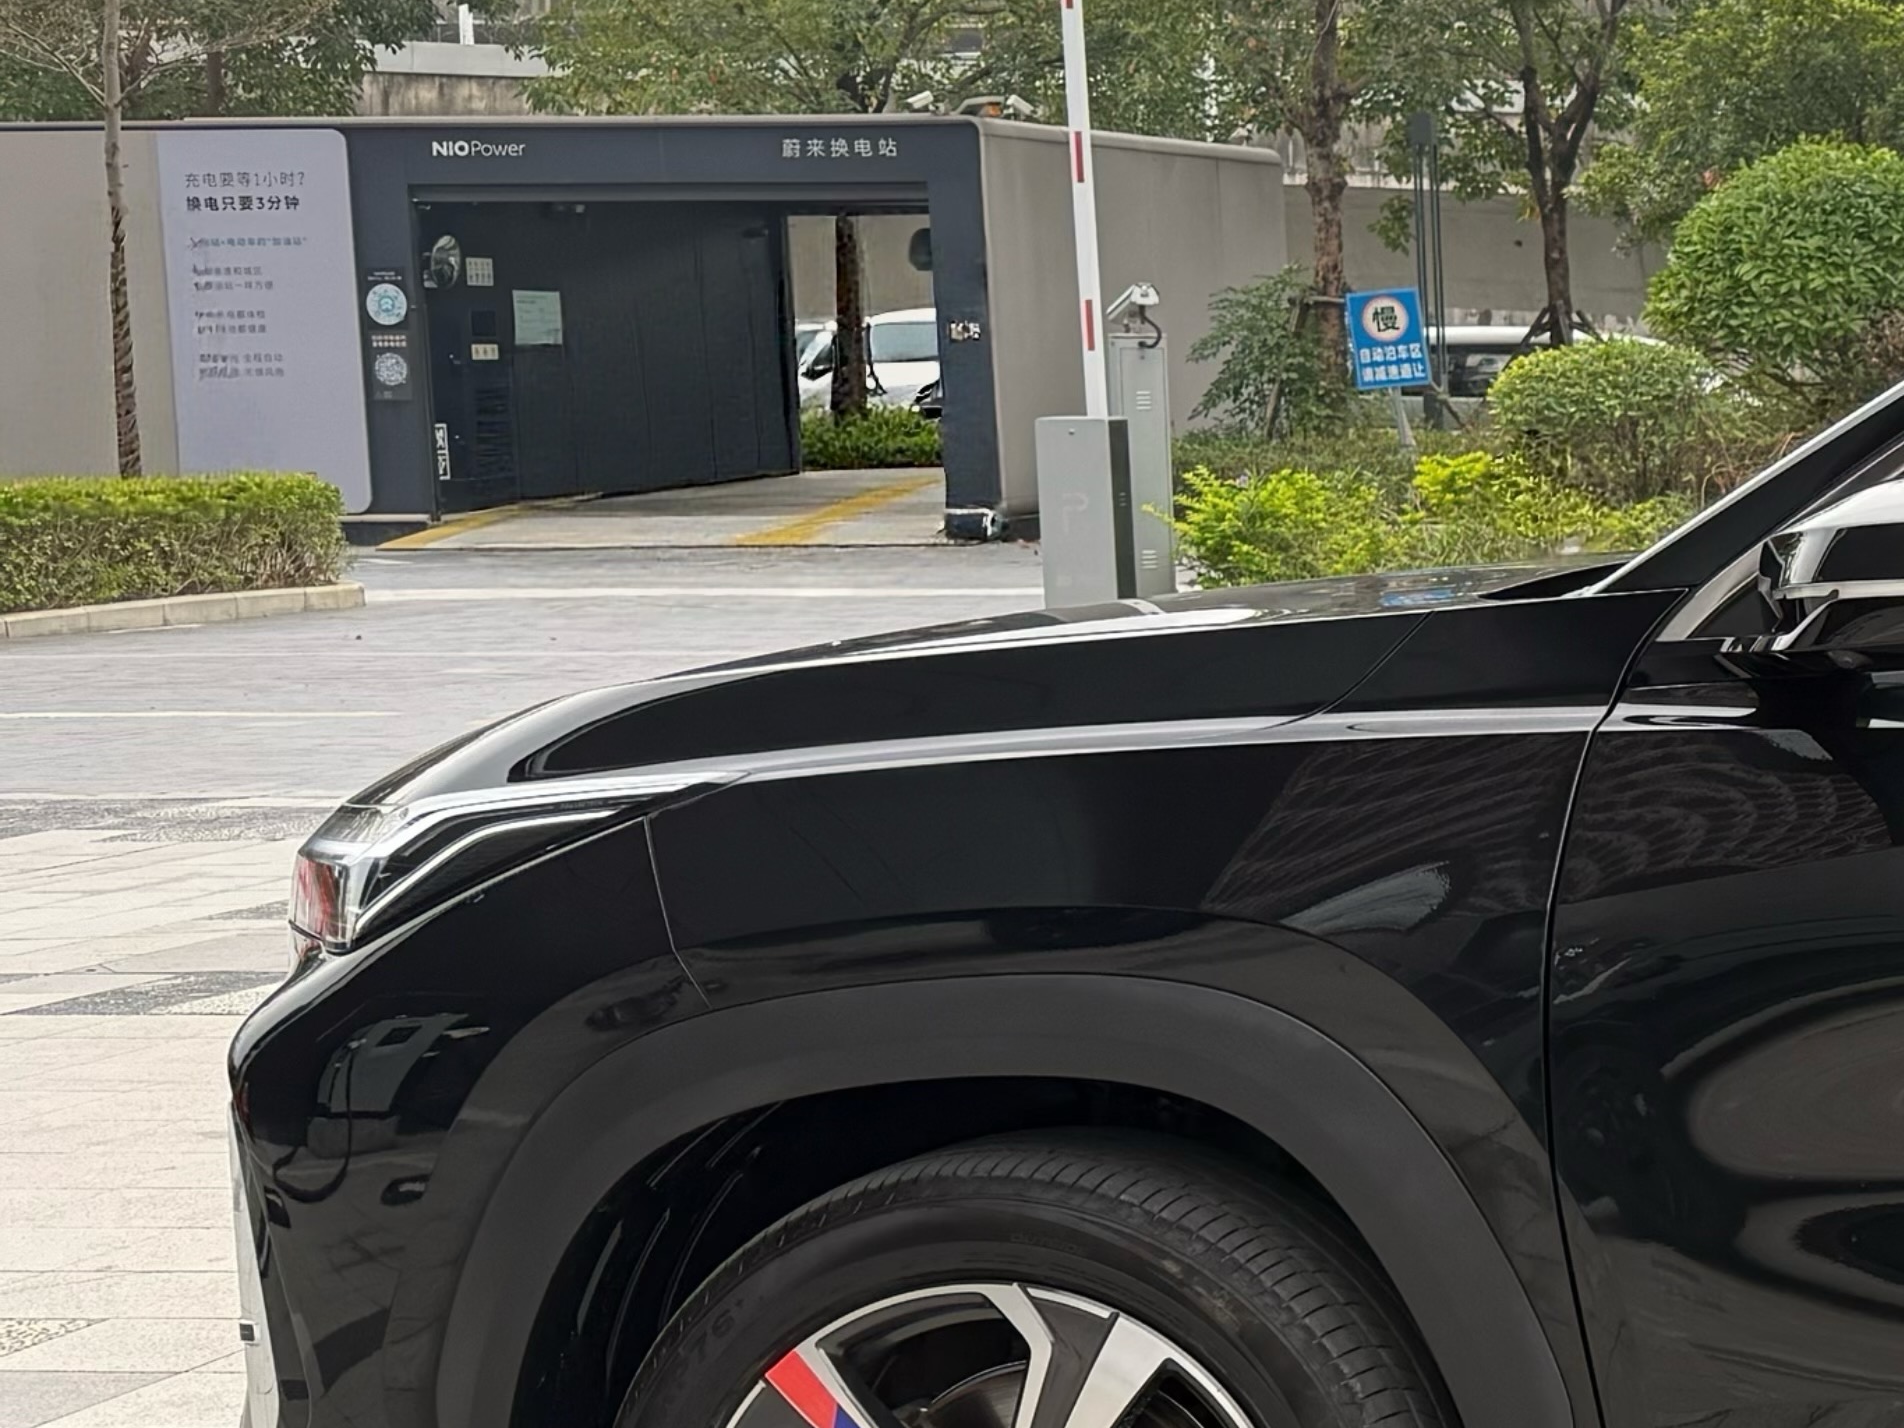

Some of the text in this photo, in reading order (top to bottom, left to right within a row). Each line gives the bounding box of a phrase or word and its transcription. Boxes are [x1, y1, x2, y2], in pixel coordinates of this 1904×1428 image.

[782, 138, 898, 158] 蔚来换电站
[186, 196, 300, 211] 换电只要3分钟
[1372, 306, 1400, 333] 慢
